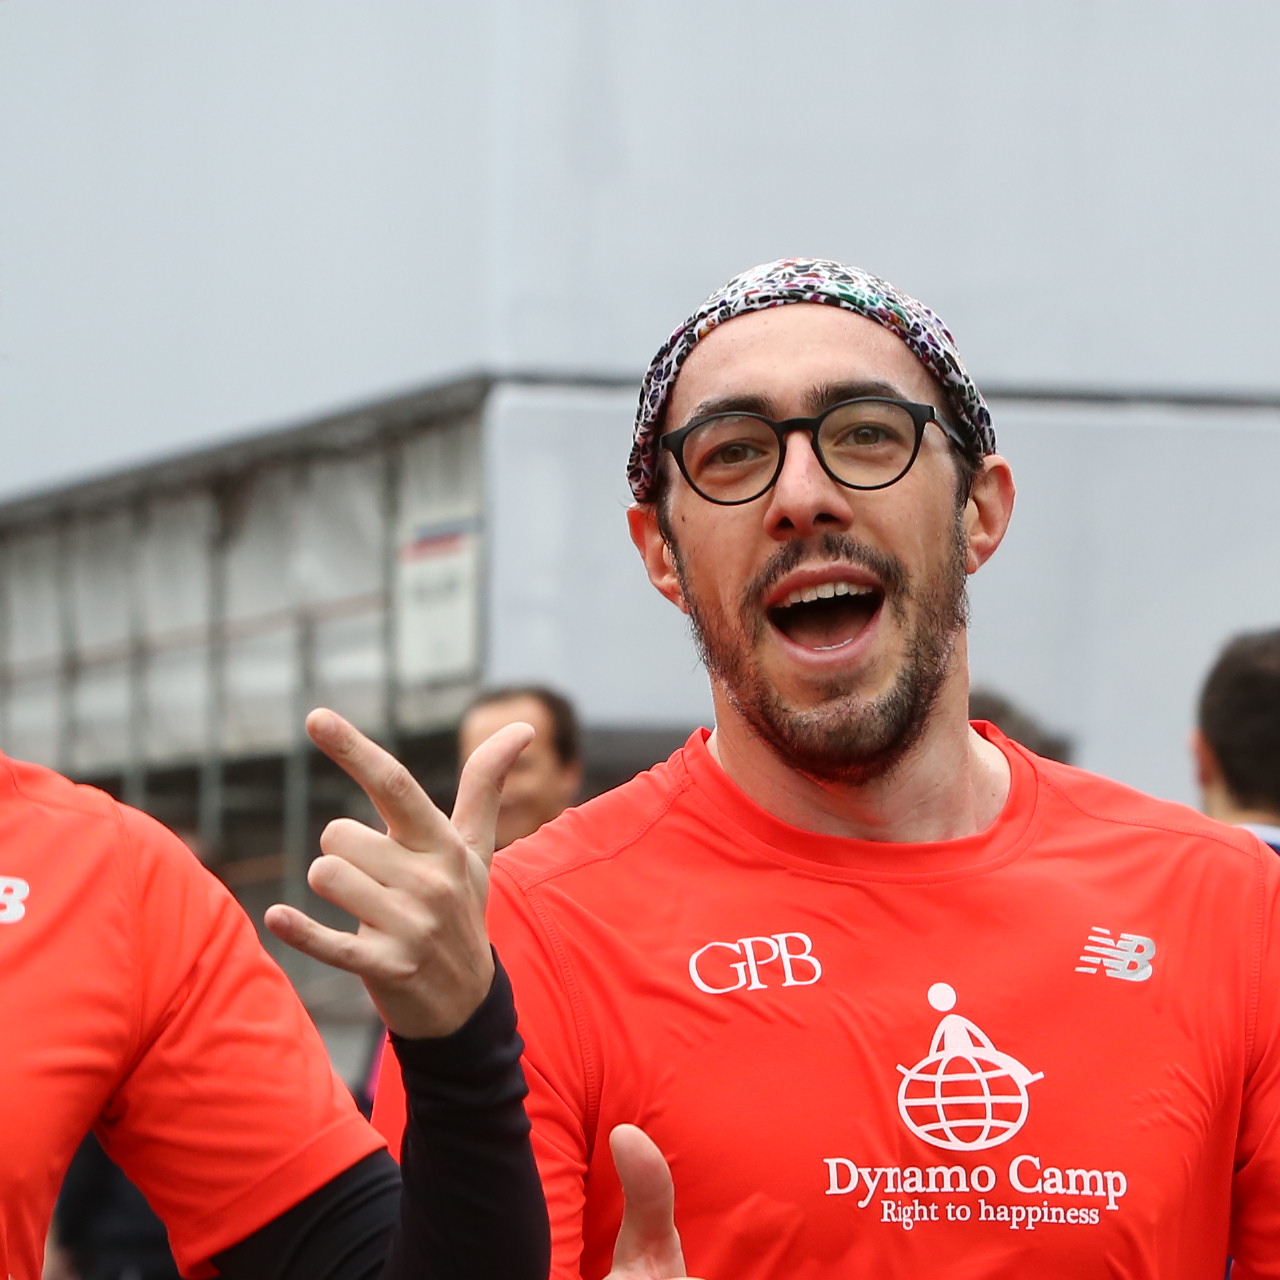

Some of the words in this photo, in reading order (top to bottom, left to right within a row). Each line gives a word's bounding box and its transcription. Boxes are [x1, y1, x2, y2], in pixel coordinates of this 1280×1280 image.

[688, 931, 823, 994] GPB
[823, 1157, 996, 1209] Dynamo
[1008, 1155, 1128, 1210] Camp
[880, 1199, 939, 1230] Right
[946, 1202, 971, 1222] to
[977, 1201, 1101, 1230] happiness
